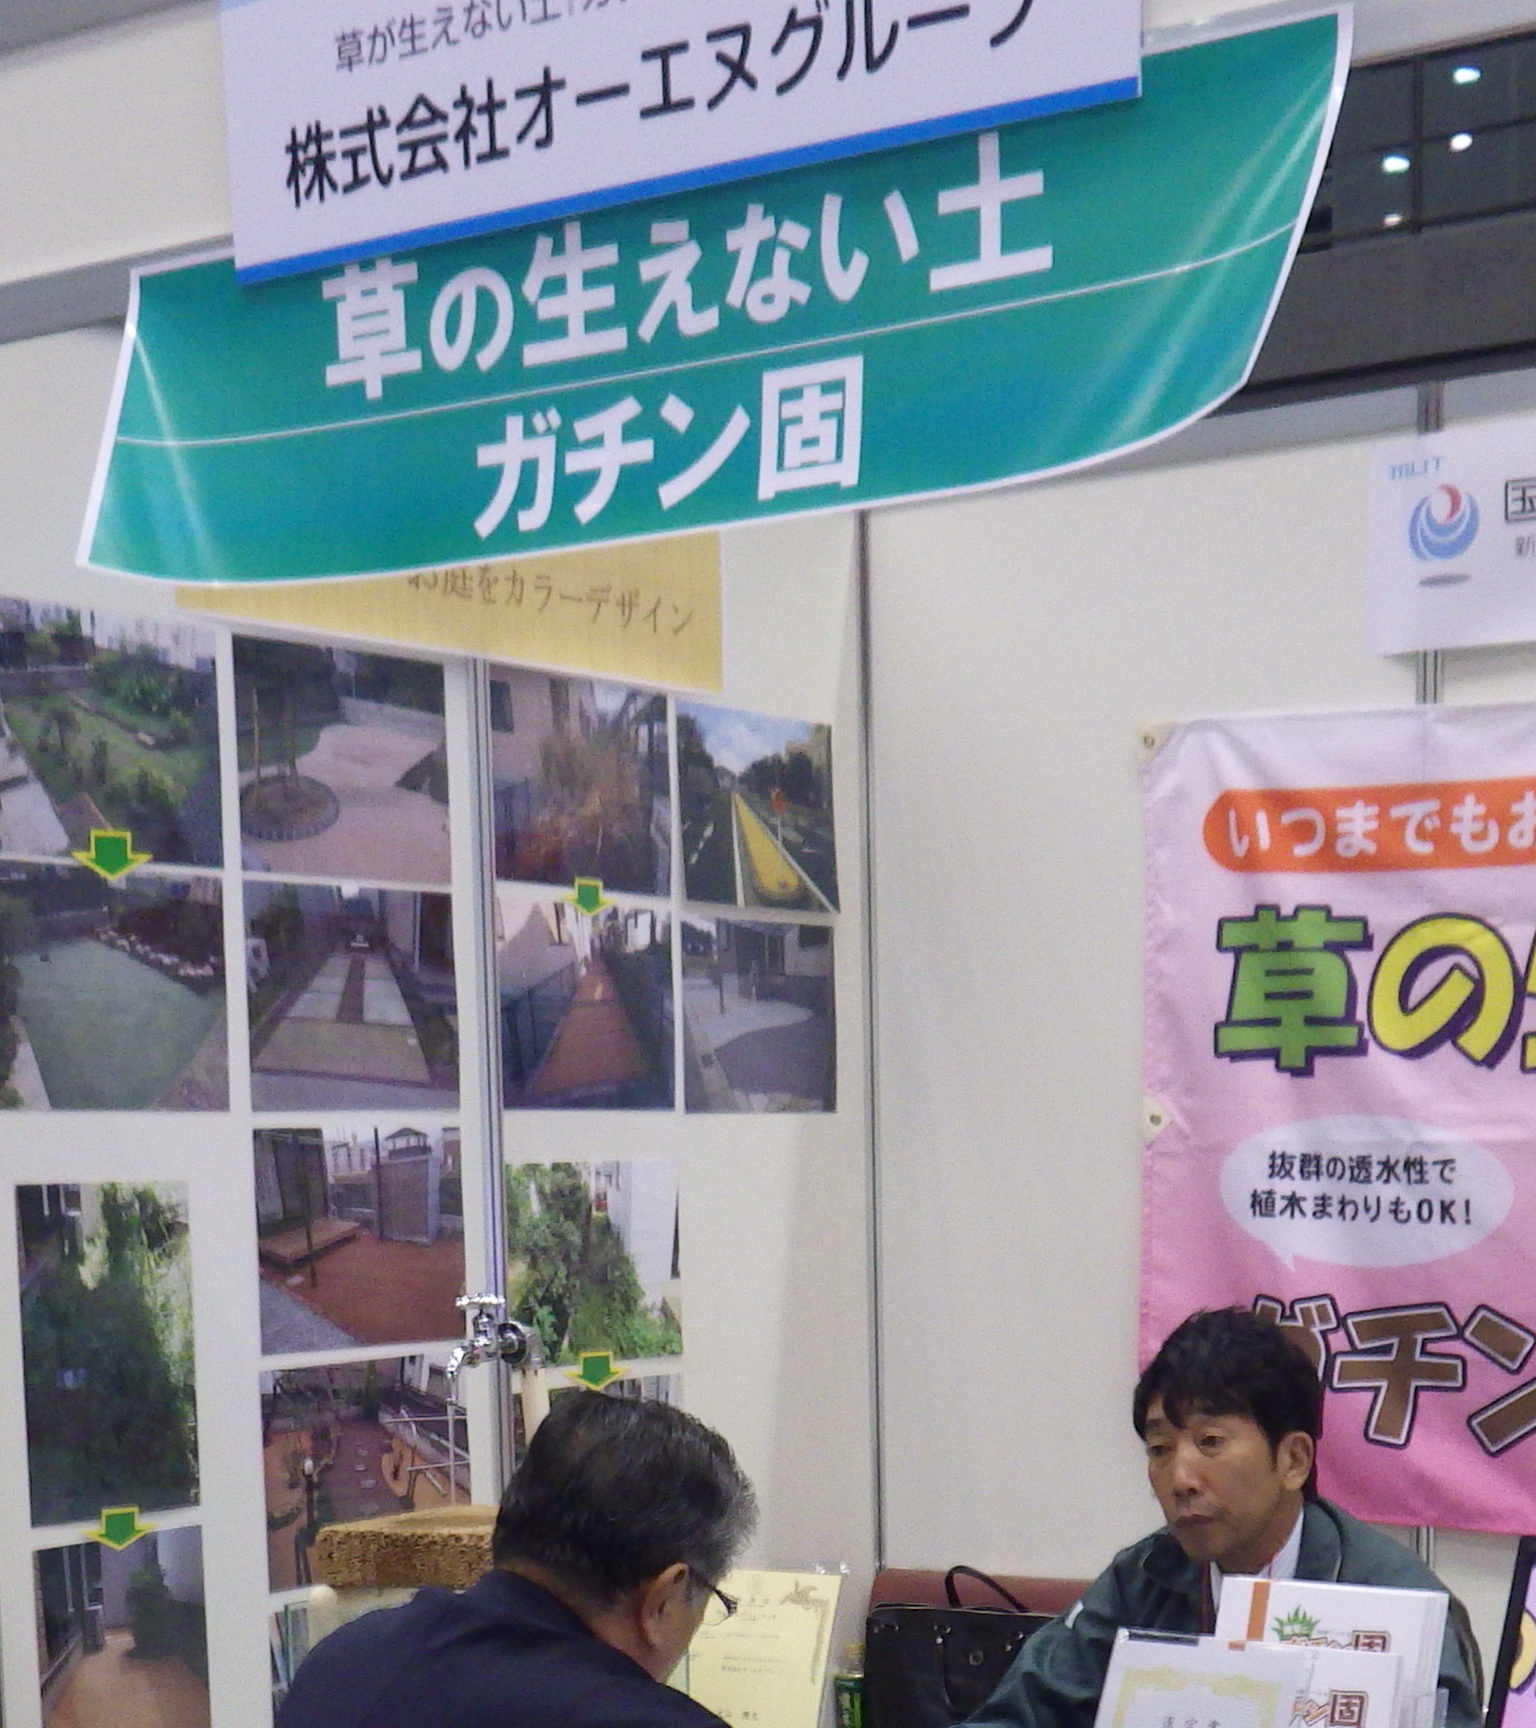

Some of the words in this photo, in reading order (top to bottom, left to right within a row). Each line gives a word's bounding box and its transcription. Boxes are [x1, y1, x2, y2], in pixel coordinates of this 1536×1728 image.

[322, 131, 1053, 399] 草の生えない土
[473, 354, 865, 540] ガチン固
[1249, 1188, 1472, 1226] 植木まわりもOK!
[1267, 1150, 1457, 1186] 抜群の透水性で
